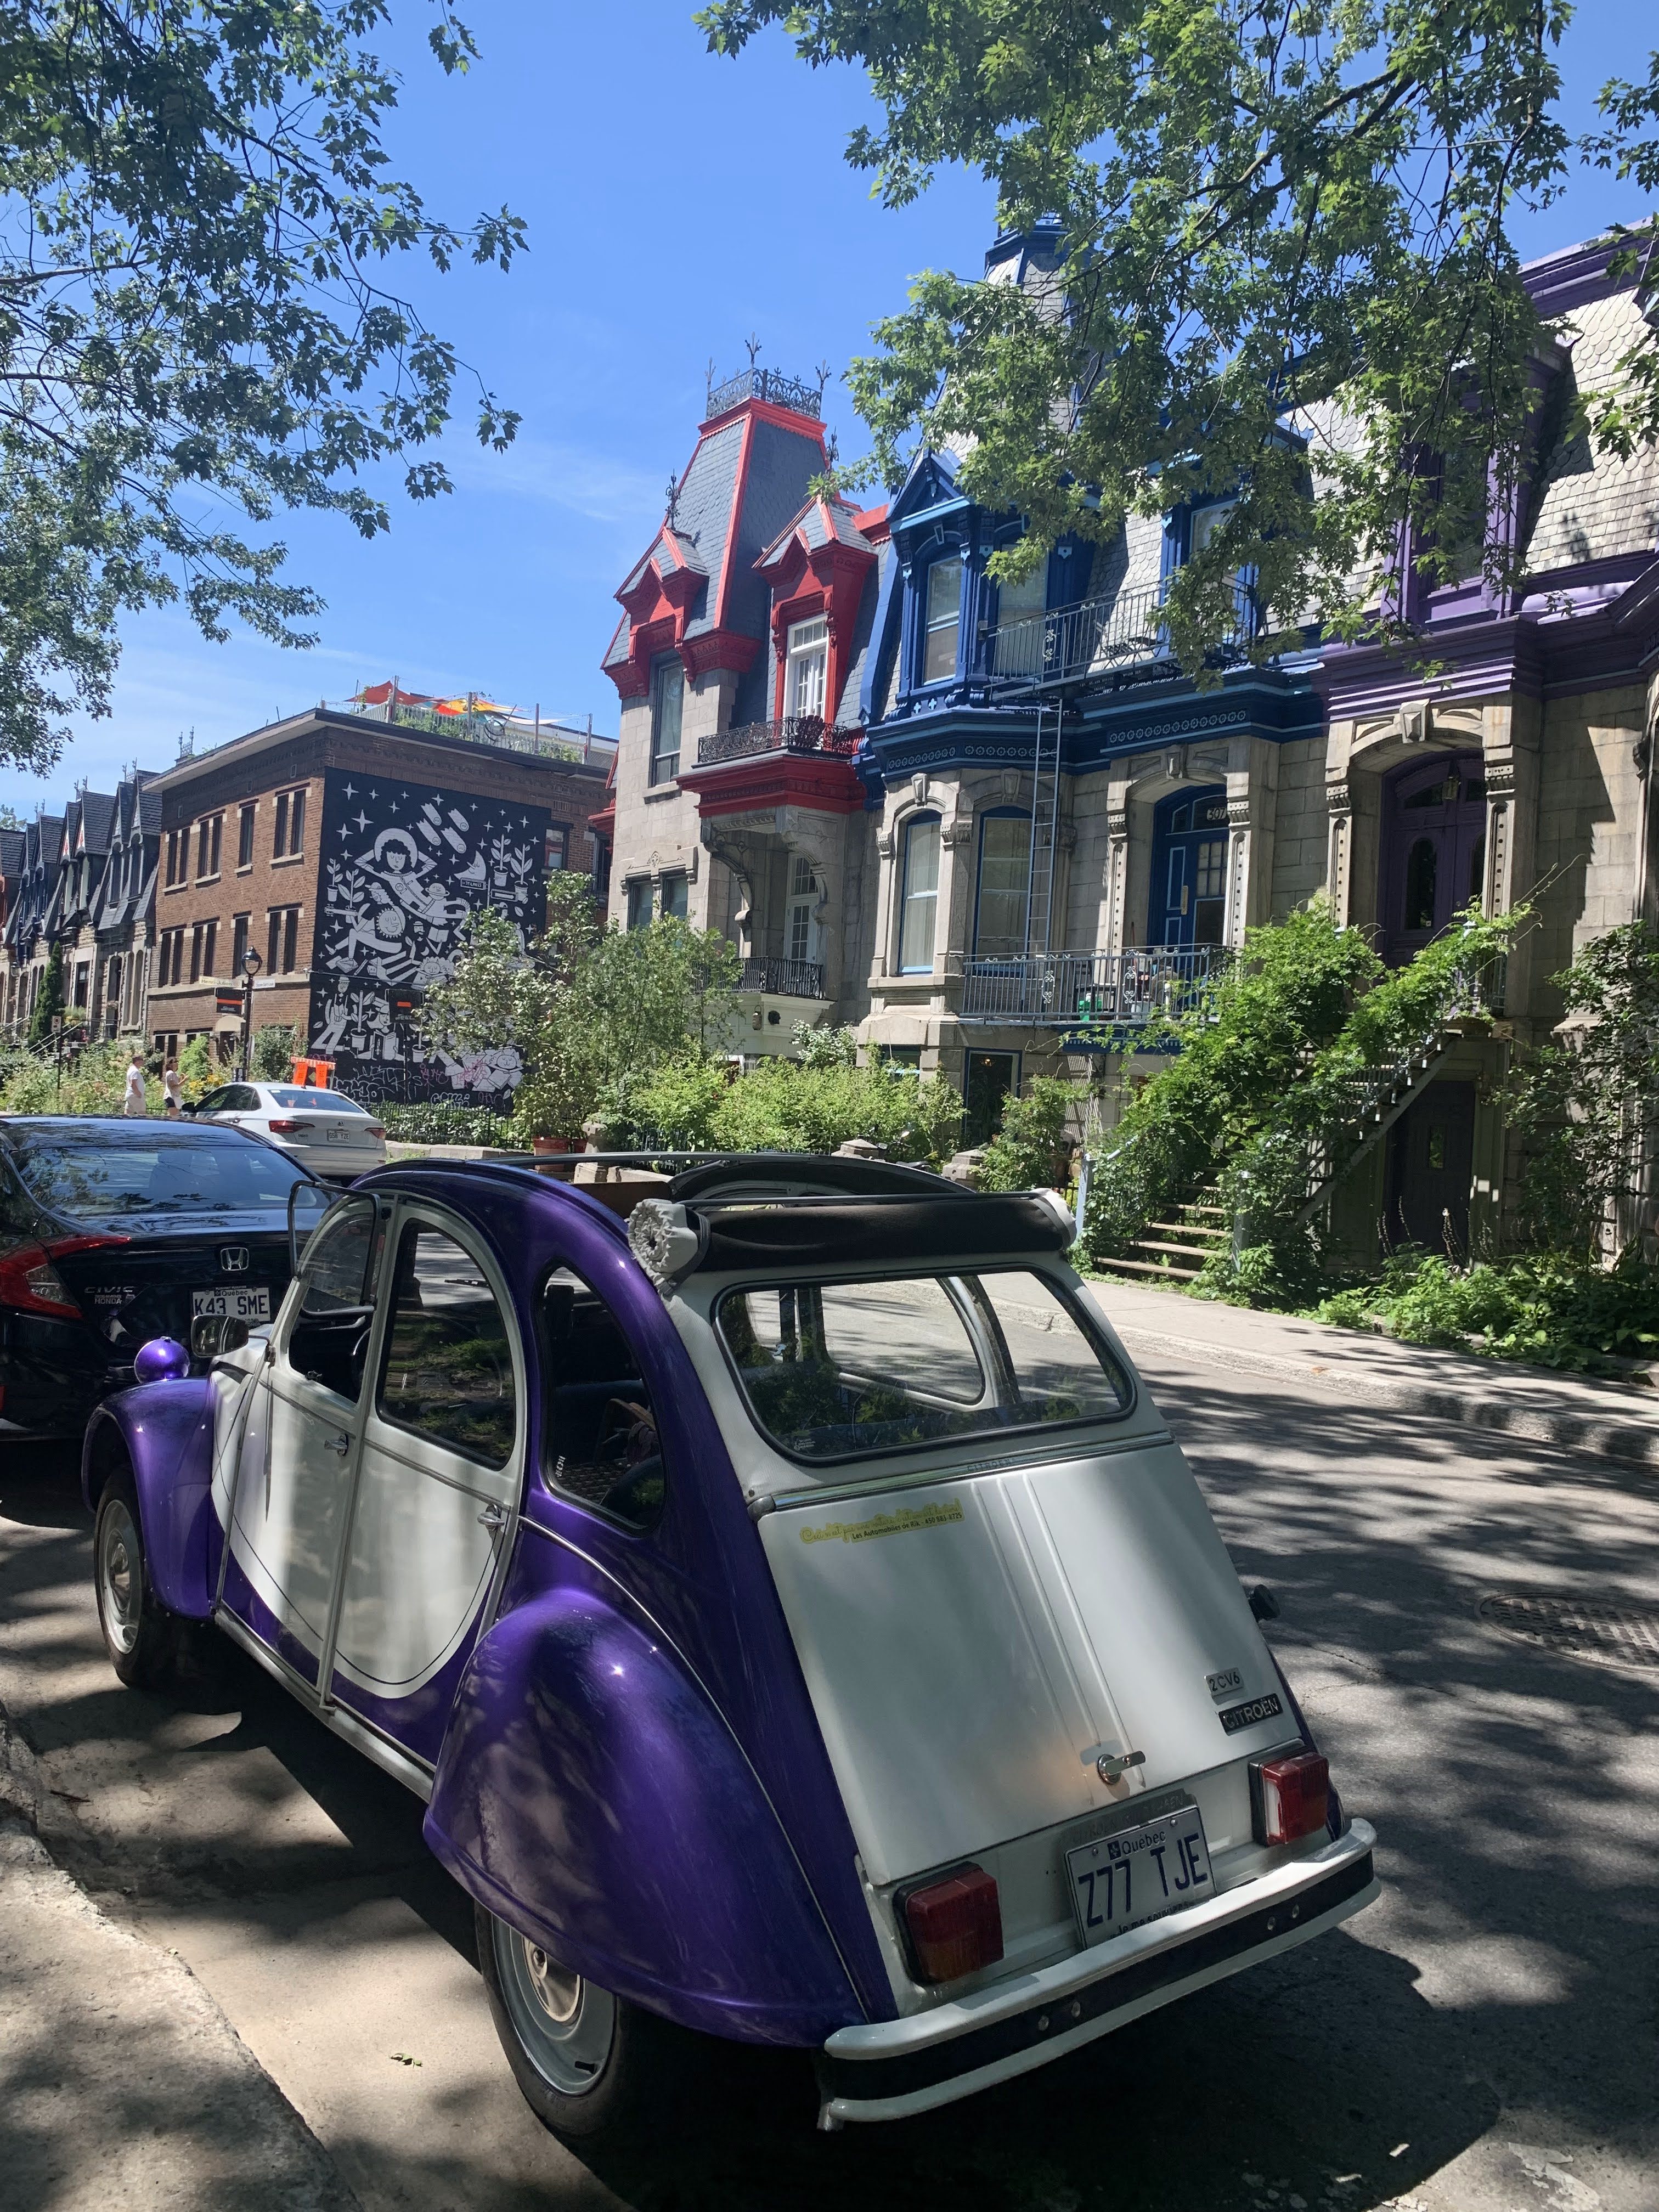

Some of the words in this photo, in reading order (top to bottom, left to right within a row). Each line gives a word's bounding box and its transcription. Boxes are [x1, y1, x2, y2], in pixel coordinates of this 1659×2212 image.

[1207, 807, 1226, 820] 307
[194, 1297, 227, 1316] K43
[237, 1295, 269, 1316] SME
[864, 1523, 900, 1537] Automobiles
[1209, 1672, 1240, 1691] 2CV6
[1223, 1697, 1279, 1728] CITROËN
[1121, 1830, 1166, 1855] Québec
[1077, 1859, 1131, 1928] Z77
[1150, 1832, 1208, 1897] TJE
